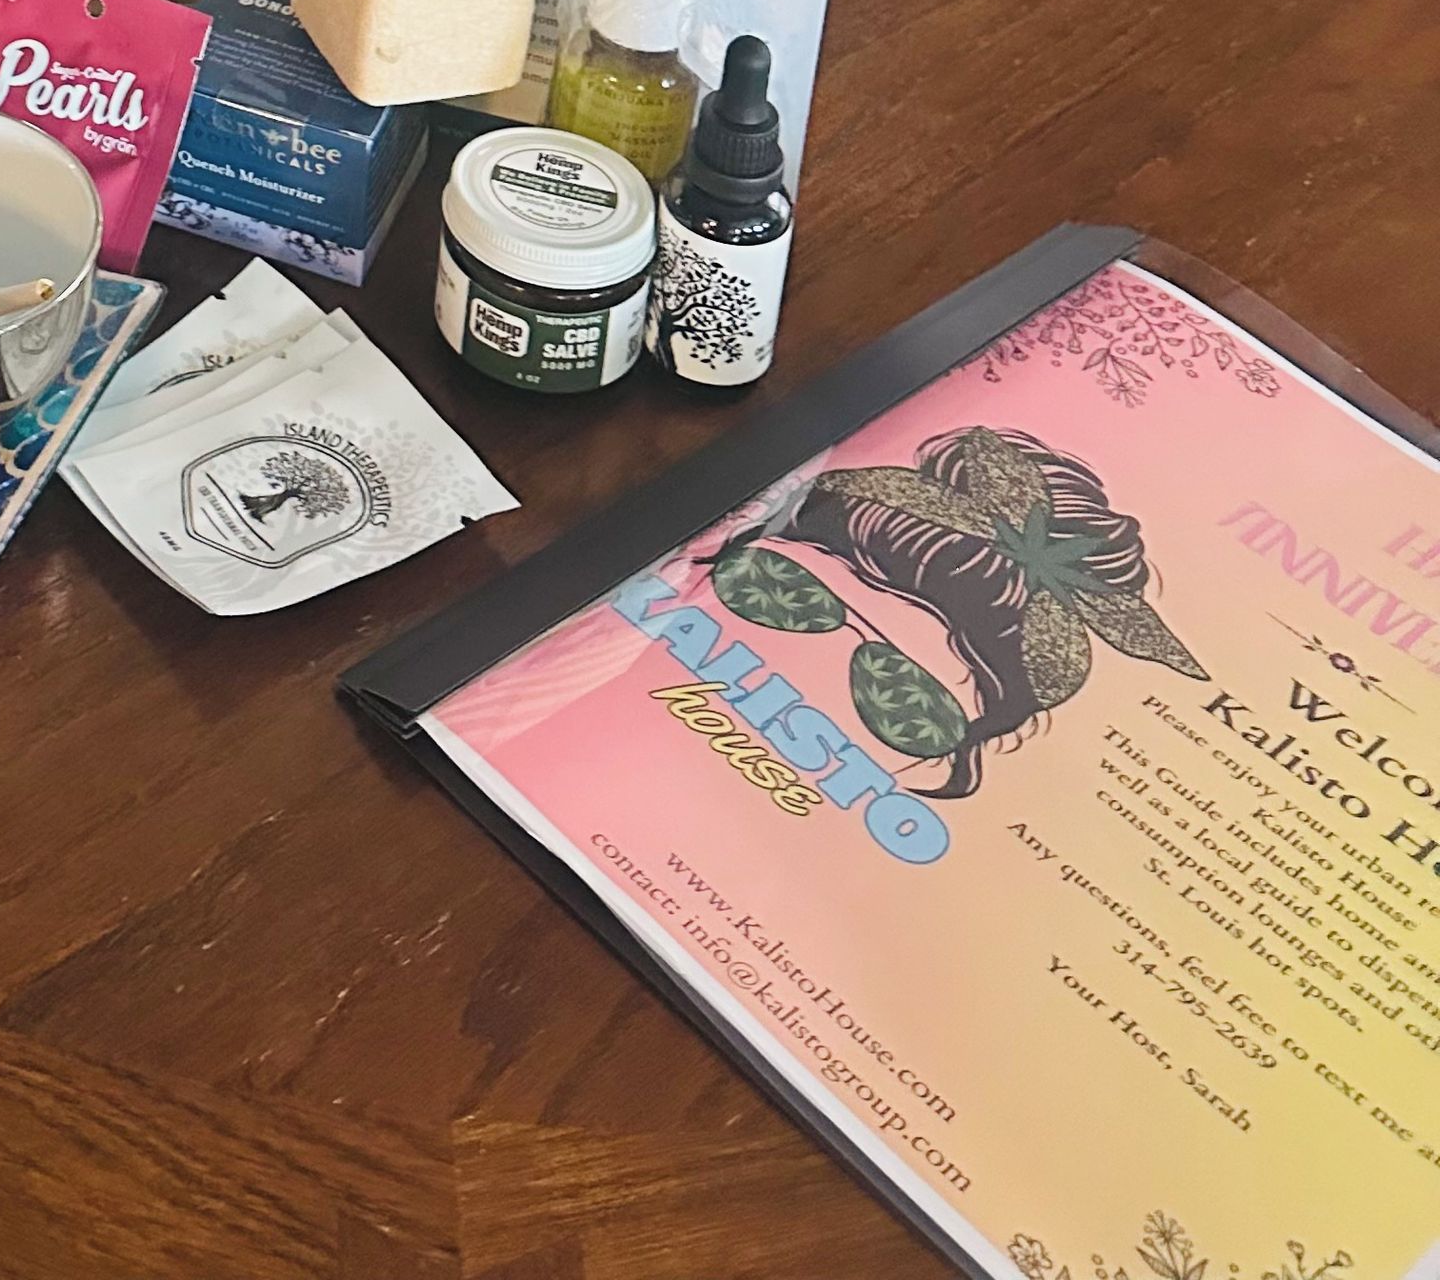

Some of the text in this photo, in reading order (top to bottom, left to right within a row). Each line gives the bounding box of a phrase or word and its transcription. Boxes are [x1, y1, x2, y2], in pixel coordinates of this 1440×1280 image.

[83, 125, 104, 147] by
[177, 149, 236, 179] Quench
[238, 167, 326, 205] Moisturizer
[291, 127, 342, 165] bee
[535, 162, 580, 181] Kings
[537, 152, 583, 171] Hemp
[474, 318, 521, 354] Kings
[476, 303, 523, 339] Hemp
[535, 314, 604, 327] THERAPEUTIC
[542, 342, 599, 360] SALVE
[563, 326, 601, 344] CBD
[282, 421, 392, 529] ISLAND THERAPEUTICS
[609, 572, 951, 865] KALISTO
[649, 681, 823, 816] house
[1200, 687, 1372, 820] Kalisto
[1289, 676, 1440, 813] Welco
[1098, 756, 1149, 796] well
[1146, 796, 1172, 819] as
[1174, 815, 1192, 831] a
[1193, 824, 1252, 878] local
[1249, 876, 1324, 930] guide
[1326, 925, 1355, 954] to
[1103, 724, 1150, 769] This
[1155, 766, 1223, 822] Guide
[1227, 819, 1323, 897] includes
[1325, 893, 1401, 954] home
[1140, 693, 1440, 919] Please enjoy your urban re
[1250, 806, 1419, 934] Kalisto House
[1095, 787, 1248, 908] consumption
[1248, 900, 1347, 984] lounges
[1348, 979, 1407, 1026] and
[1142, 855, 1366, 1034] St. Louis hot spots.
[590, 831, 972, 1194] contact: info@kalistogroup.com
[665, 850, 957, 1124] www.KalistoHouse.com
[1007, 820, 1061, 864] Any
[1058, 861, 1173, 960] questions,
[1178, 954, 1232, 998] feel
[1227, 993, 1279, 1039] free
[1281, 1036, 1311, 1063] to
[1313, 1061, 1368, 1108] text
[1369, 1105, 1417, 1143] me
[1046, 952, 1253, 1135] Your Host, Sarah
